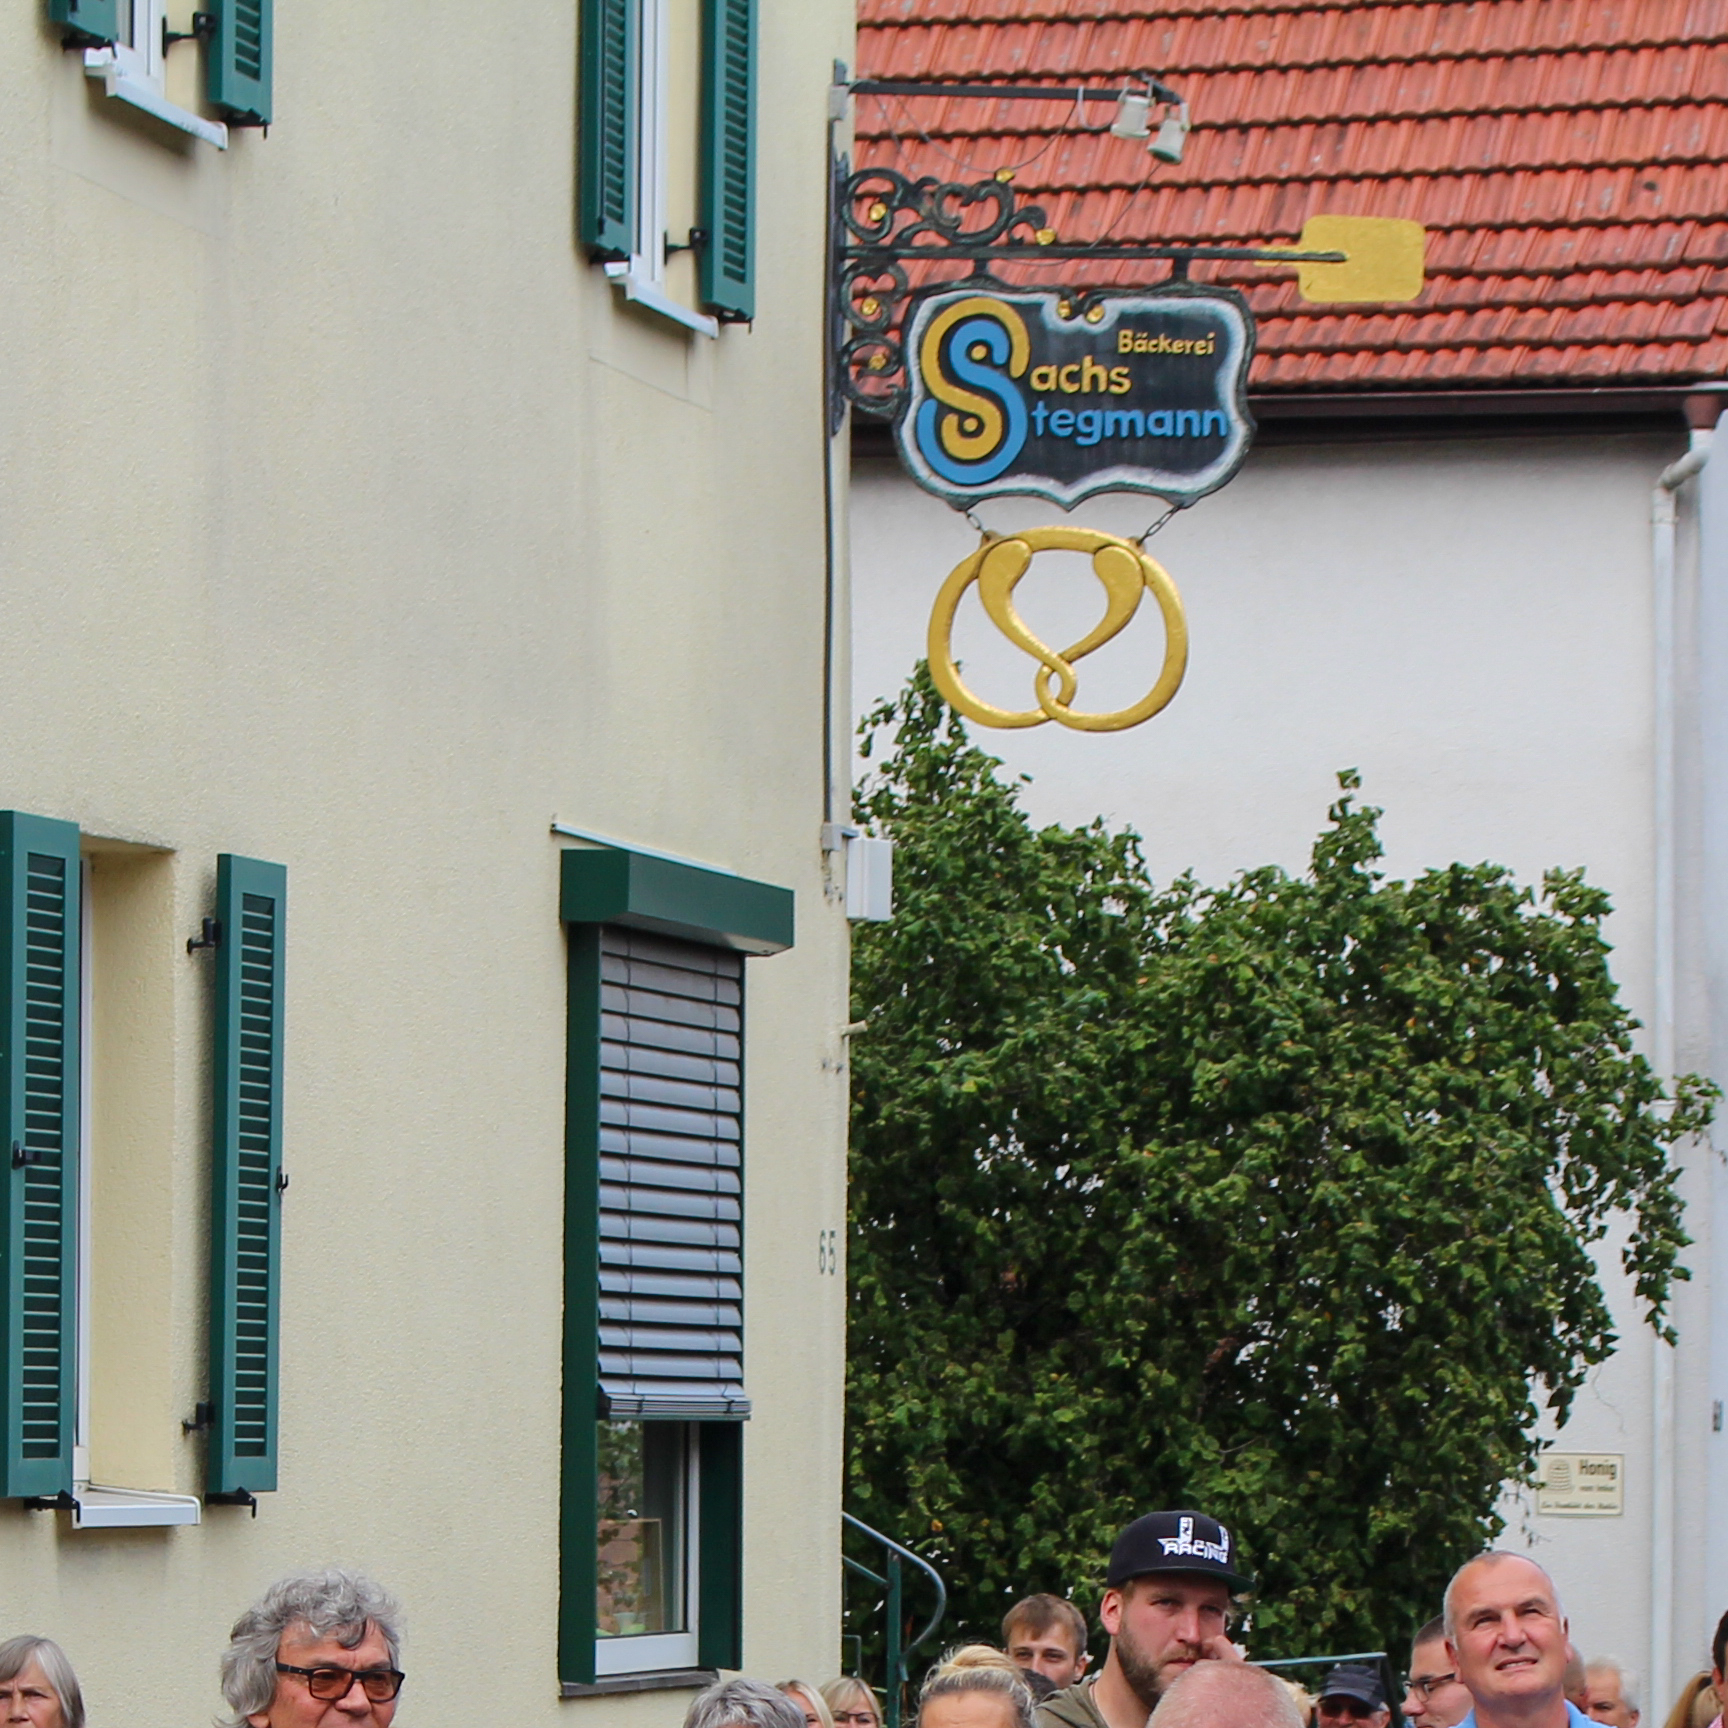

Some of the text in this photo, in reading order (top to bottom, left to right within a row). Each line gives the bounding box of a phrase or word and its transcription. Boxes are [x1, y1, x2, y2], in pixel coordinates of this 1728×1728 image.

[1117, 329, 1215, 356] Bäckerei
[917, 319, 1229, 485] Stegmann
[922, 297, 1132, 460] Sachs
[819, 1229, 836, 1276] 65
[1579, 1459, 1617, 1481] Honig
